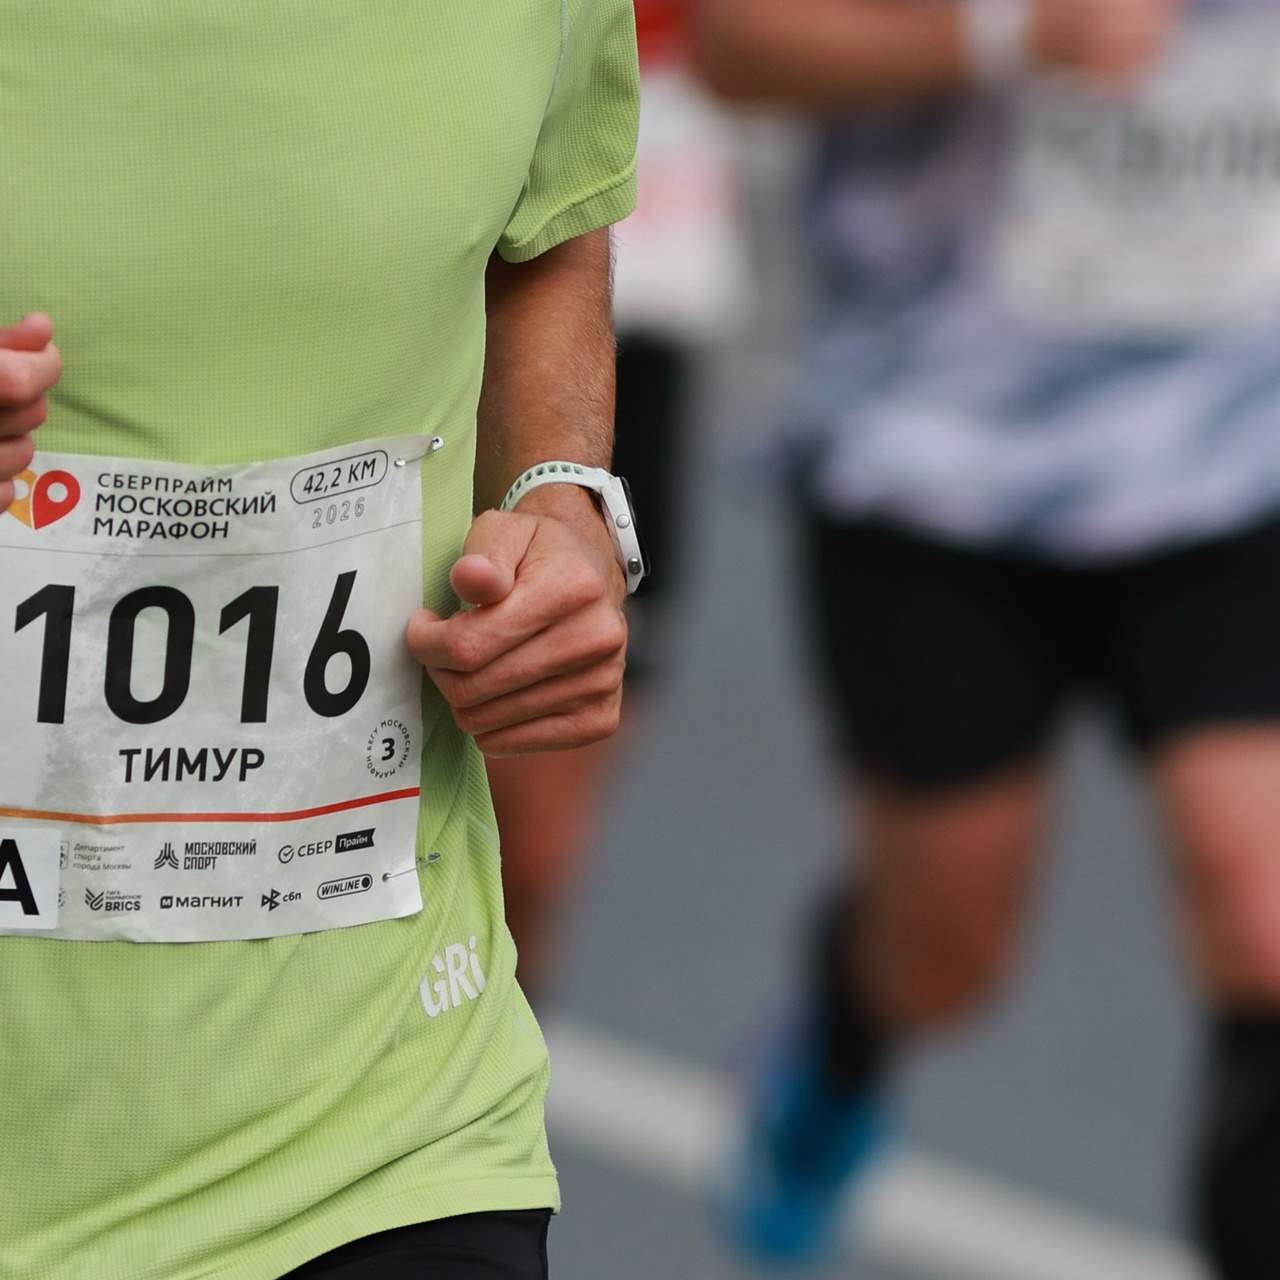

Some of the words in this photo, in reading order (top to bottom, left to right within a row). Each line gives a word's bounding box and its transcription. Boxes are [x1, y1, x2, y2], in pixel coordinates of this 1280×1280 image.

[97, 473, 233, 494] СБЕРПРАЙМ
[303, 467, 341, 494] 42,2
[95, 491, 276, 517] МОСКОВСКИЙ
[312, 497, 365, 528] 2026
[93, 517, 229, 539] МАРАФОН
[14, 570, 372, 725] 1016
[382, 737, 396, 761] 3
[119, 747, 265, 783] ТИМУР
[74, 843, 125, 853] Департамент
[184, 839, 257, 856] МОСКОВСКИЙ
[297, 840, 333, 857] СБЕР
[339, 834, 368, 849] Прайм
[74, 853, 101, 862] спорта
[183, 856, 218, 870] СПОРТ
[321, 879, 360, 896] WINLINE
[105, 900, 141, 912] BRICS
